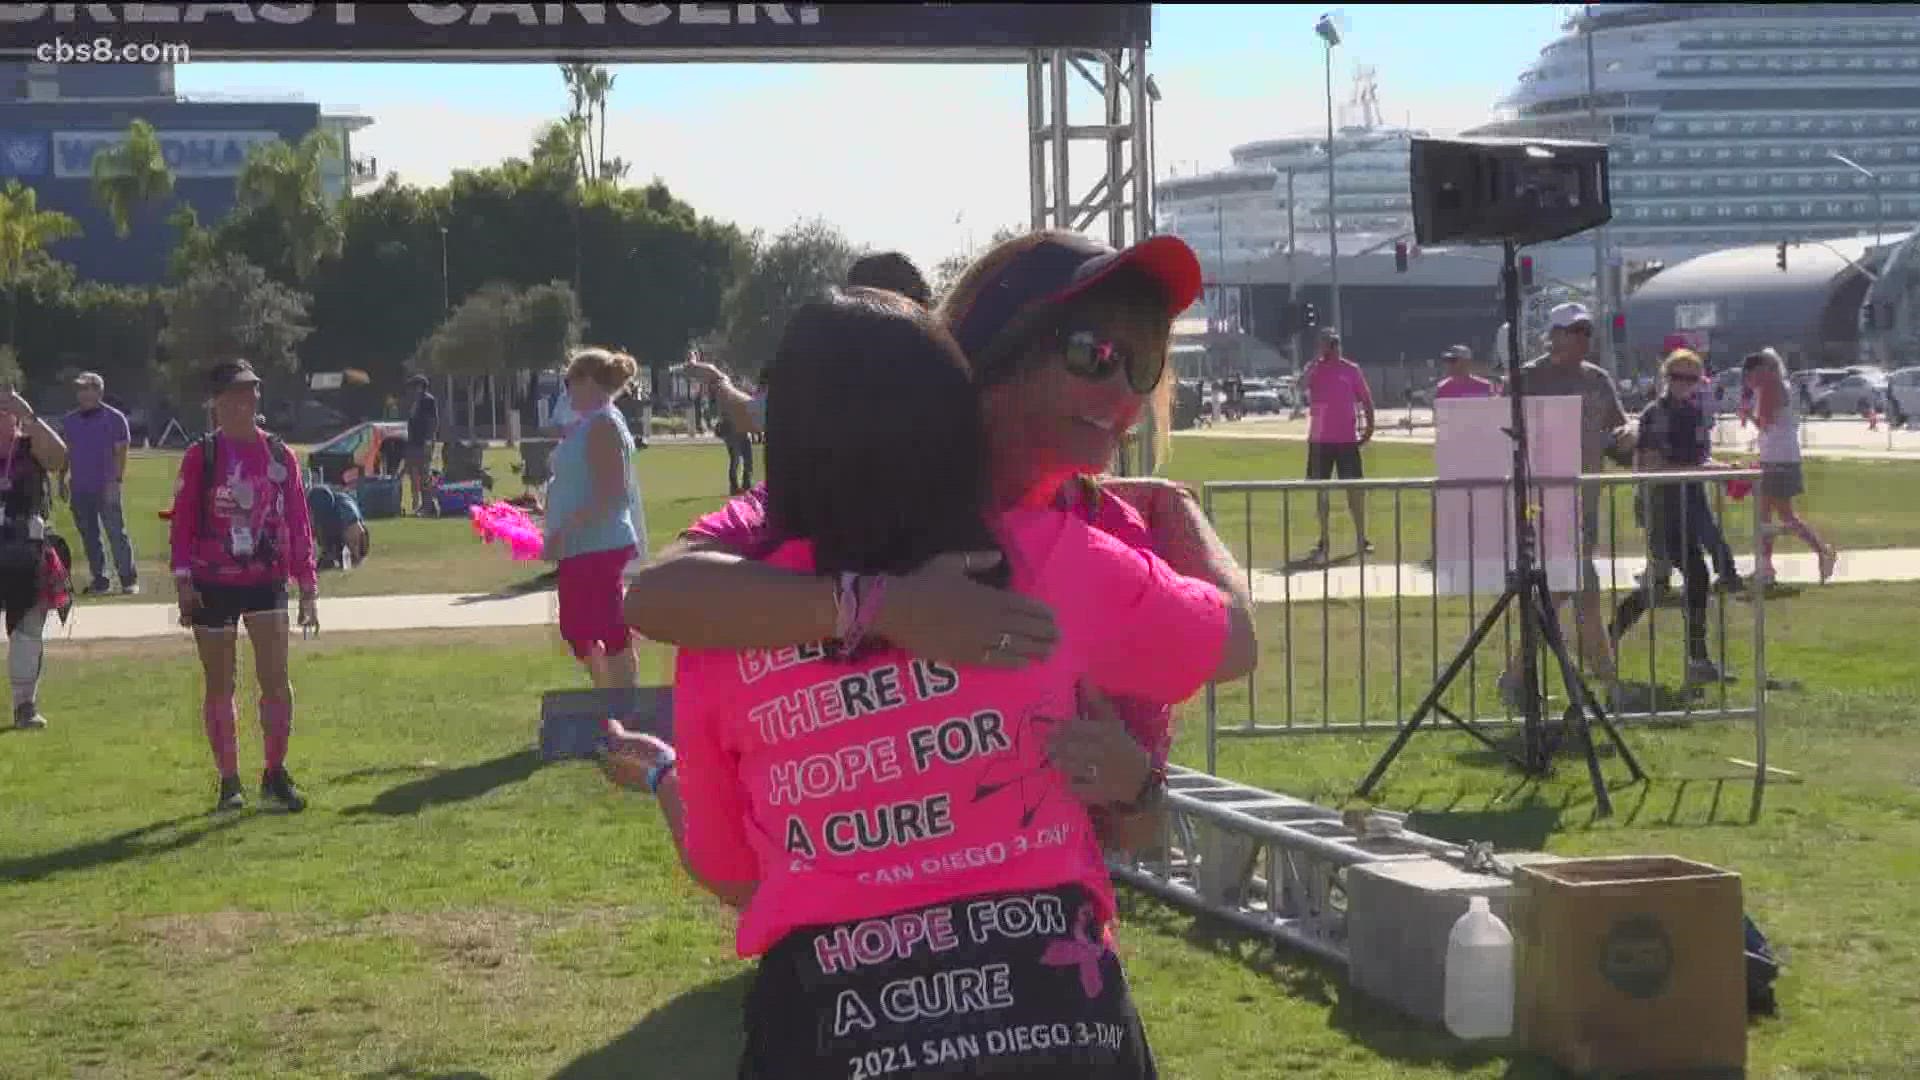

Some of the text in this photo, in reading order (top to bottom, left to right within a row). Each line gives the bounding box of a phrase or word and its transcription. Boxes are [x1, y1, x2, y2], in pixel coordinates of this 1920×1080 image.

[748, 658, 960, 744] THERE IS
[768, 709, 1012, 806] HOPE FOR
[784, 793, 955, 860] A CURE
[920, 842, 1007, 875] DIEGO
[814, 894, 1067, 975] HOPE FOR
[834, 963, 1015, 1036] A CURE
[848, 1043, 917, 1080] 2021
[921, 1034, 981, 1065] SAN
[986, 1022, 1072, 1055] DIEGO
